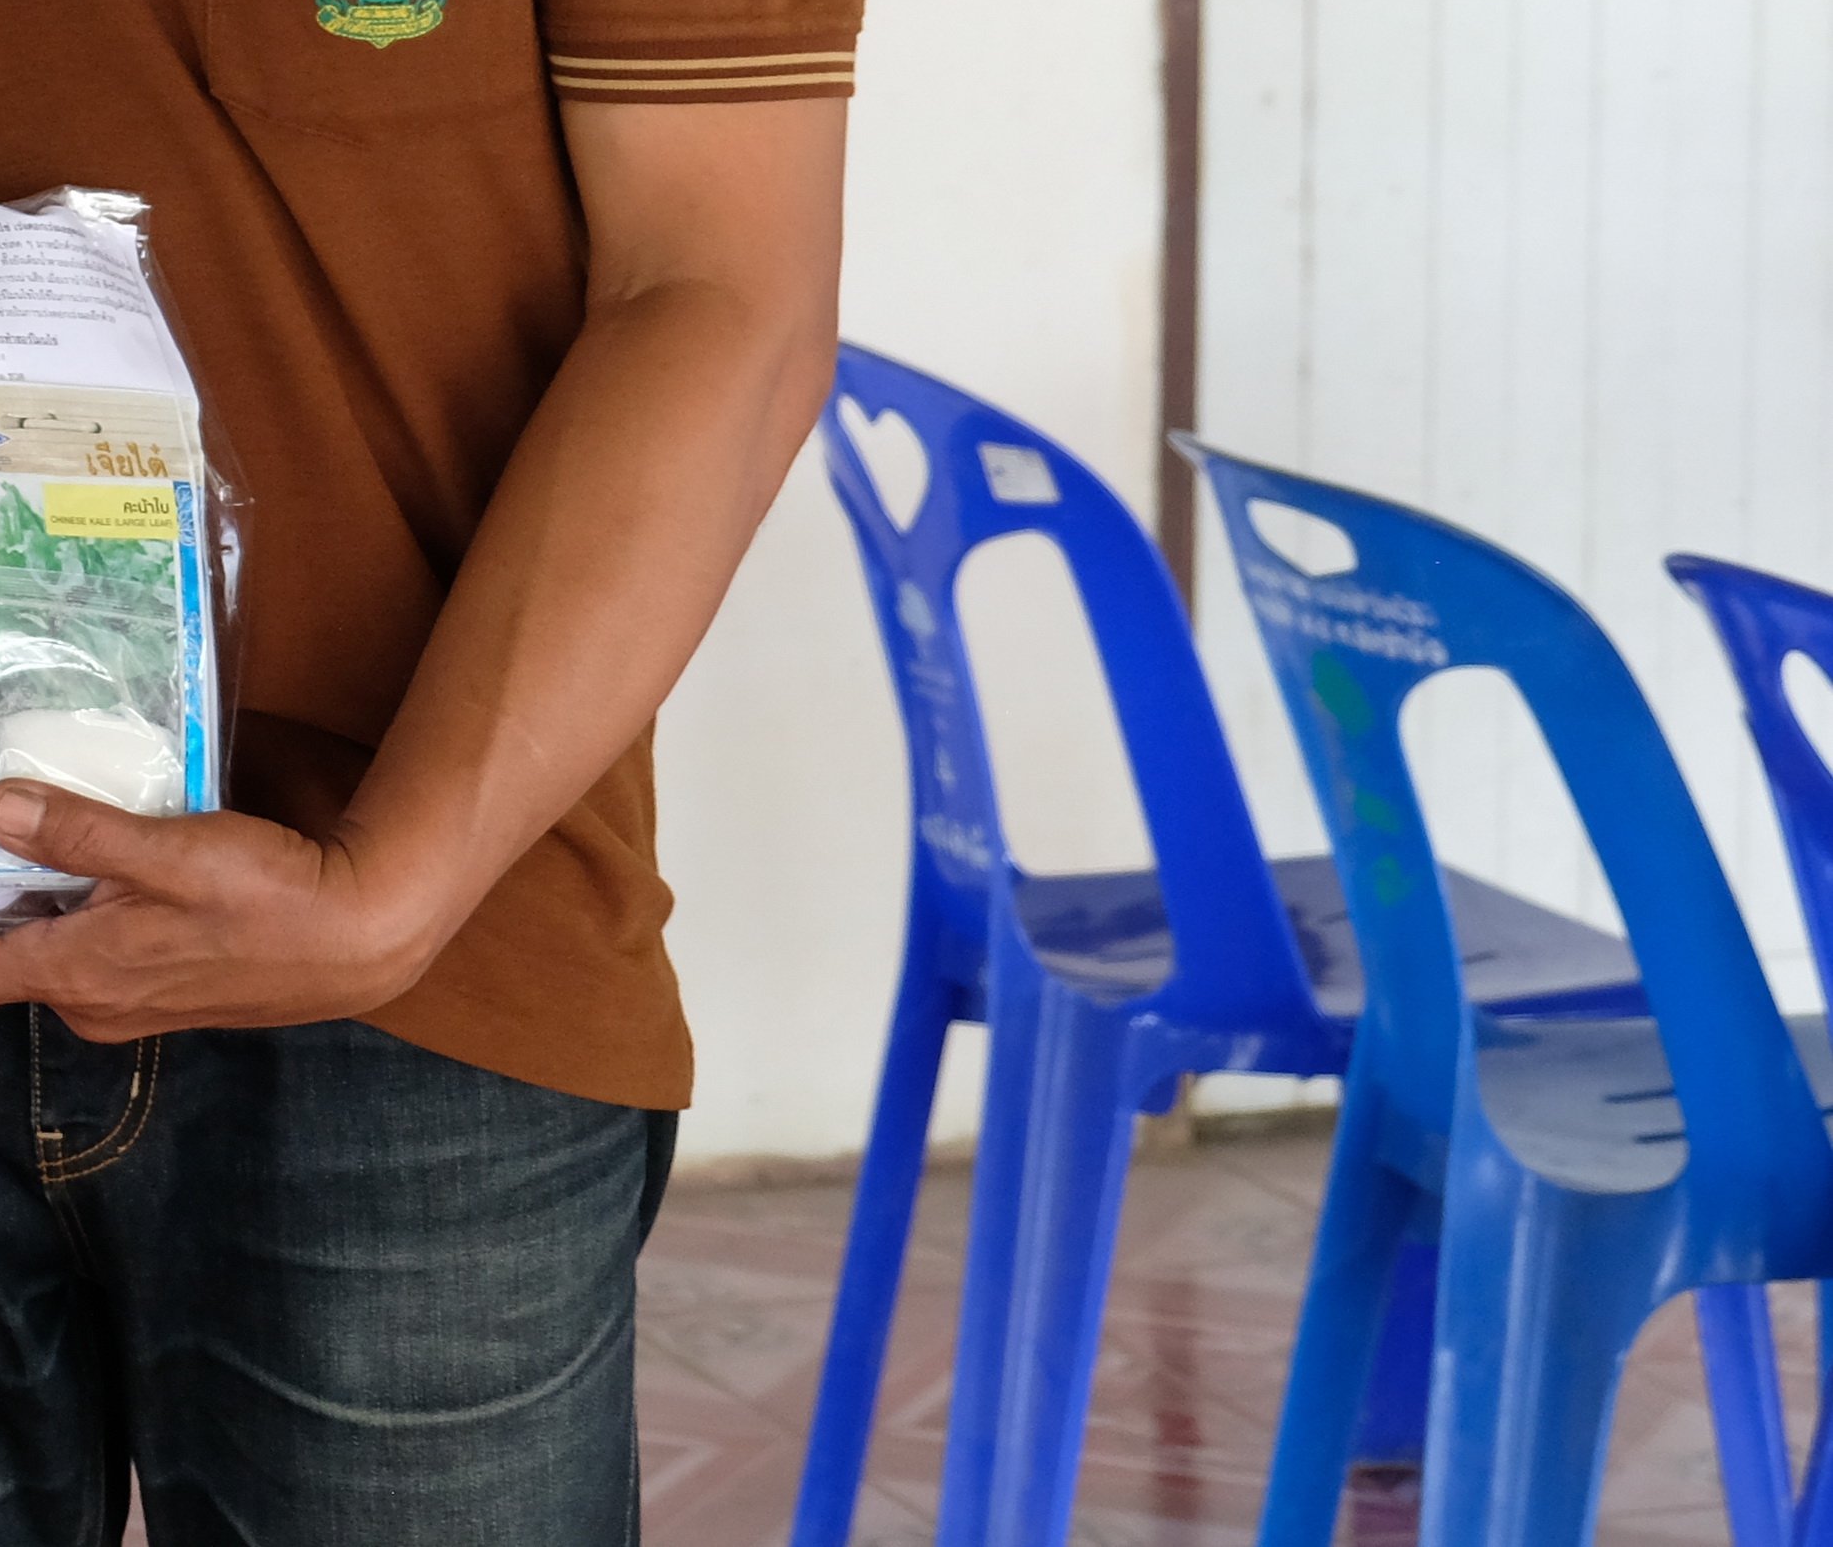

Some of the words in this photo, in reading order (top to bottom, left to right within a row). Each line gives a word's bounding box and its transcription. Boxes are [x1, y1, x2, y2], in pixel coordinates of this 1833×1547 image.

[124, 497, 169, 515] คะน้าใบ
[89, 517, 110, 526] KALE
